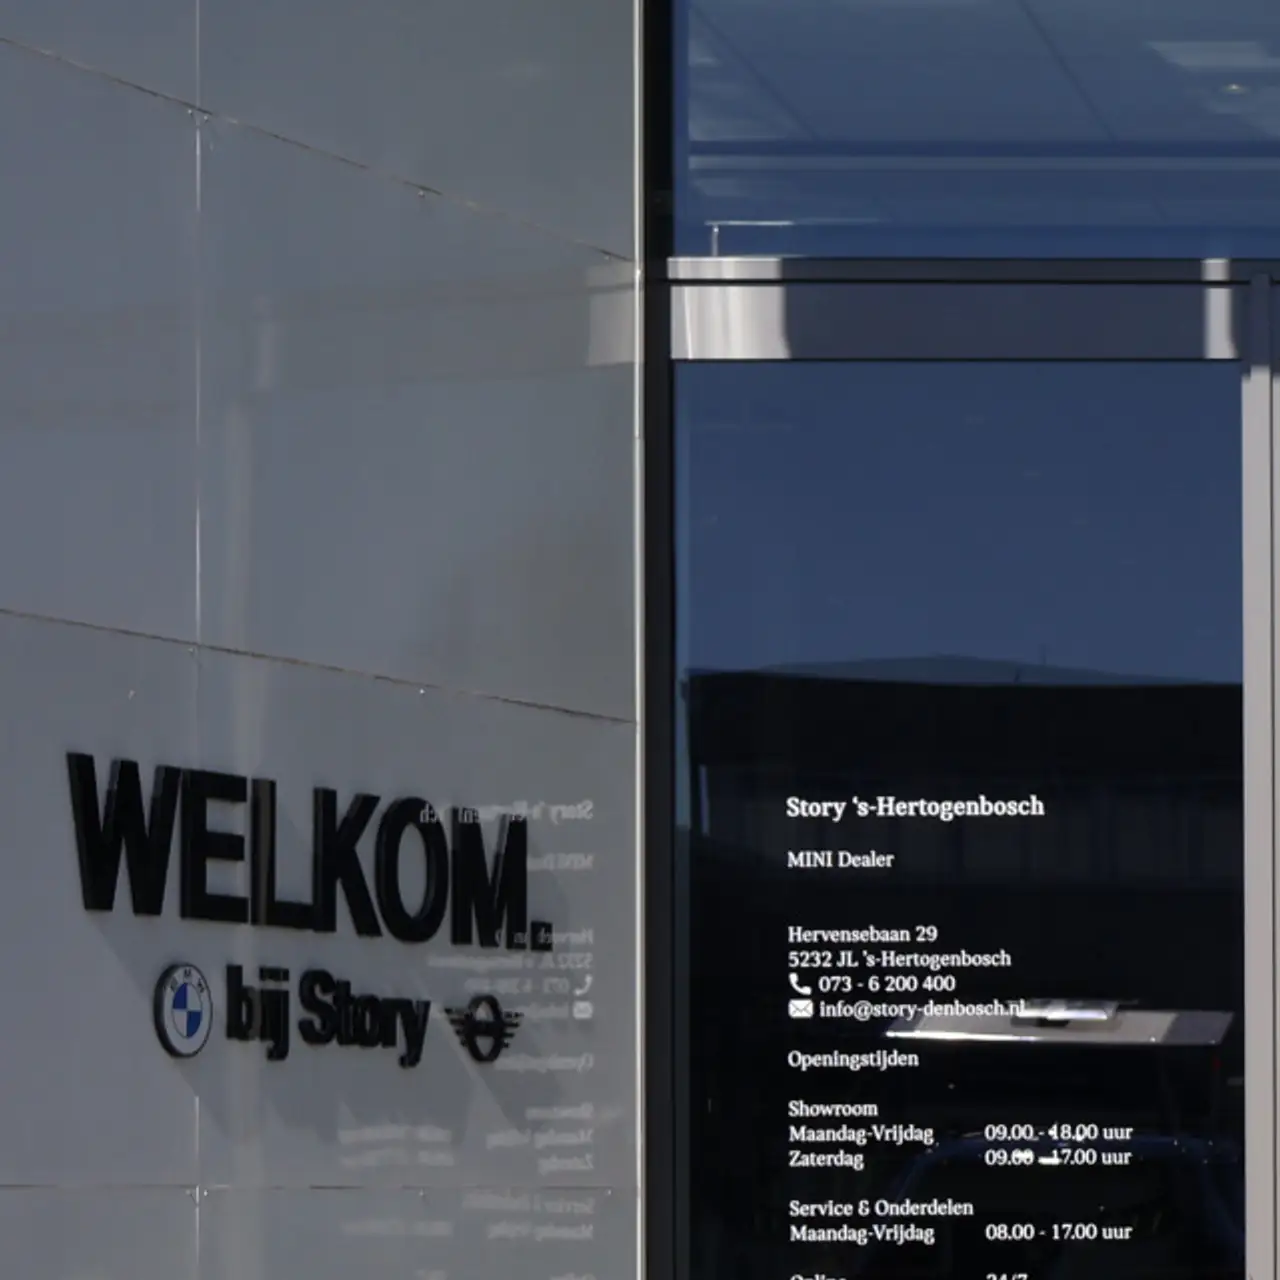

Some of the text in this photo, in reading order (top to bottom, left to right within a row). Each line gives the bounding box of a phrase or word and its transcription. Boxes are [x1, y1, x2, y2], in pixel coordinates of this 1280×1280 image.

[787, 797, 847, 822] Story
[66, 751, 553, 953] WELKOM.
[788, 850, 894, 867] MINI Dealer
[788, 925, 937, 942] Hervensebaan 29
[789, 950, 1011, 971] 5232 JL 's-Hertogenbosch
[819, 976, 852, 992] 073
[868, 976, 880, 992] 6
[885, 976, 918, 992] 200
[922, 975, 955, 991] 400
[226, 964, 431, 1068] bij Story
[820, 1000, 1025, 1020] info@story-denbosch.nl
[788, 1050, 919, 1071] Openingstijden
[788, 1100, 878, 1116] Showroom
[790, 1124, 934, 1145] Maandag-Vrijdag
[985, 1124, 1033, 1140] 09.00
[1103, 1128, 1133, 1140] uur
[789, 1150, 864, 1170] Zaterdag
[1102, 1152, 1132, 1165] uur
[790, 1199, 973, 1216] Service & Onderdelen
[791, 1224, 935, 1245] Maandag-Vrijdag
[986, 1224, 1035, 1240] 08.00
[1053, 1224, 1097, 1240] 17.00
[1102, 1227, 1132, 1240] uur
